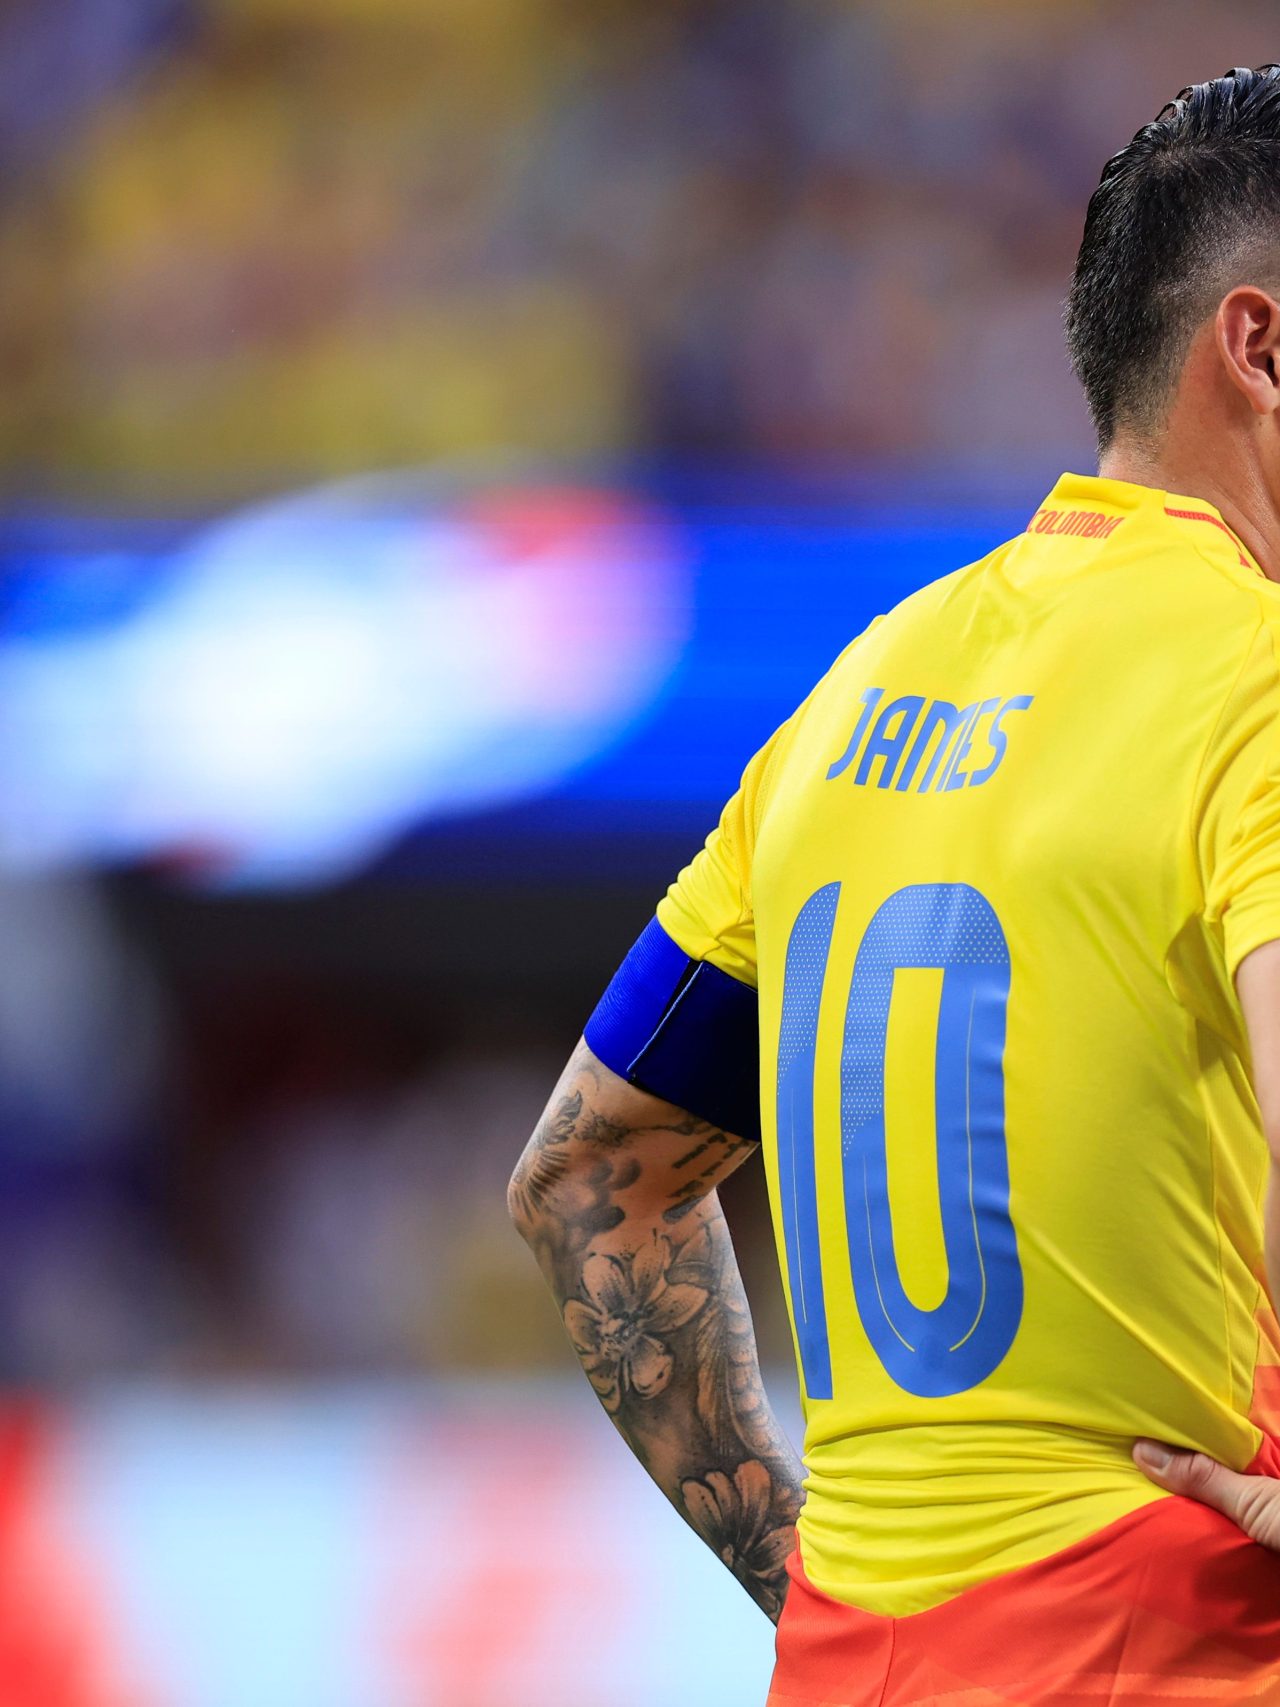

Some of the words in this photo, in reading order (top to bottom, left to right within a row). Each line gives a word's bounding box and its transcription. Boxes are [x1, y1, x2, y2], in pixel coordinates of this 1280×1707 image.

[1026, 509, 1125, 539] COLOMBIA
[825, 687, 1035, 793] JAMES
[776, 881, 1024, 1400] 10
